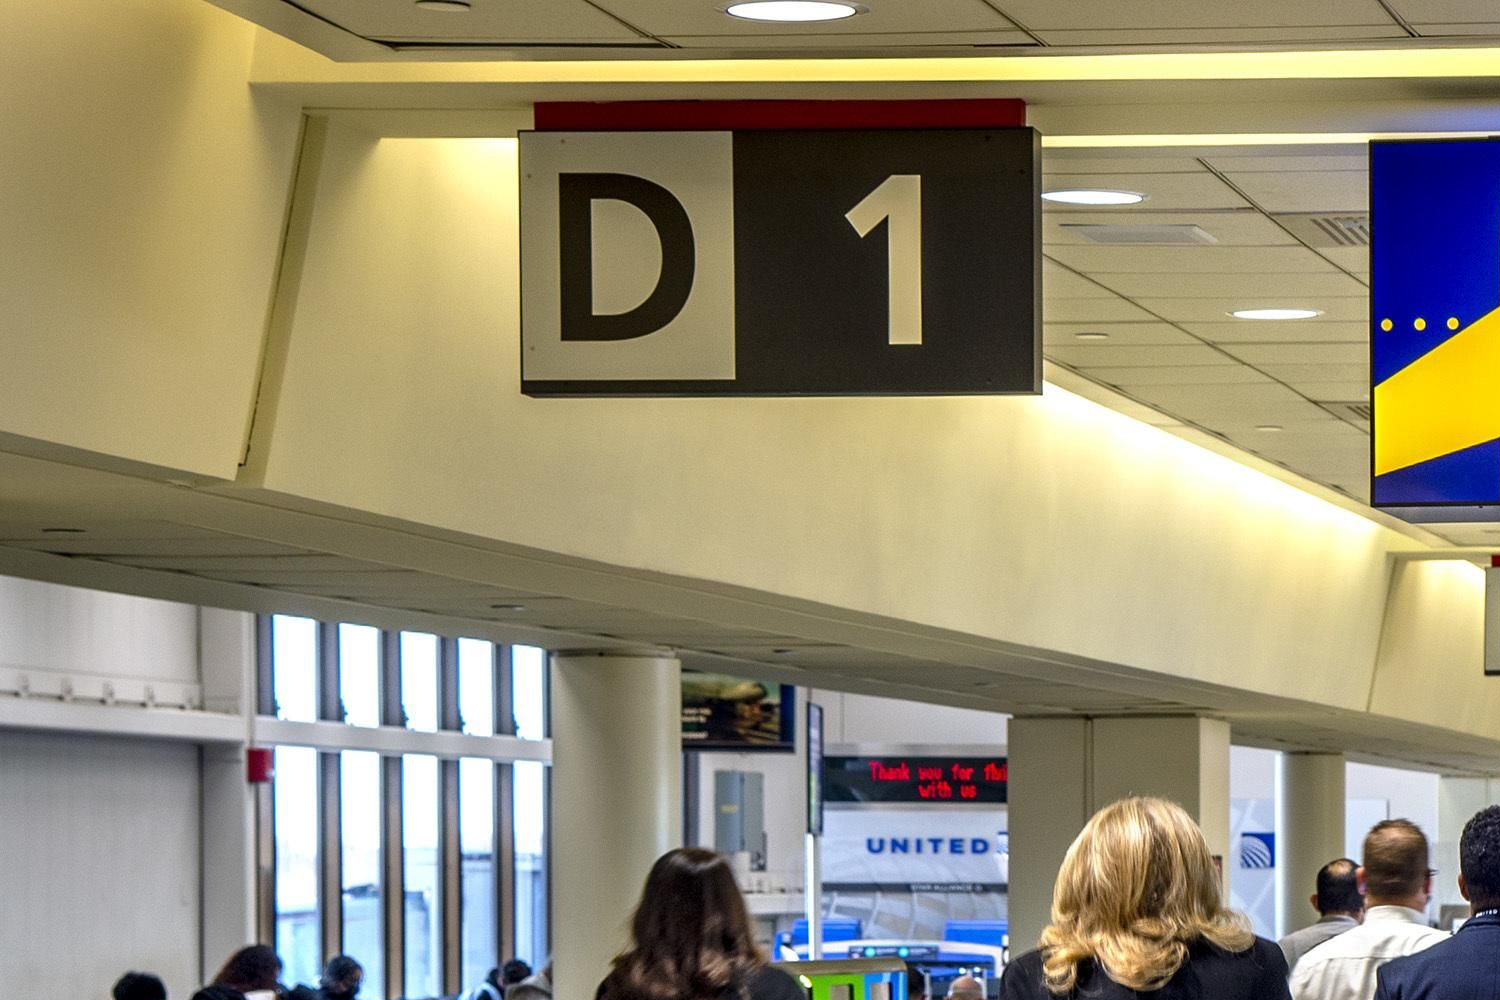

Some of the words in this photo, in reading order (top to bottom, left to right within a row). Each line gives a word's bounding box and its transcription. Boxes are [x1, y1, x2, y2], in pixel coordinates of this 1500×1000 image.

[558, 172, 696, 341] D
[844, 174, 922, 345] 1
[869, 761, 910, 781] Thank
[918, 766, 942, 781] you
[952, 763, 974, 780] for
[918, 781, 952, 798] with
[960, 784, 977, 798] us
[866, 838, 989, 854] UNITED
